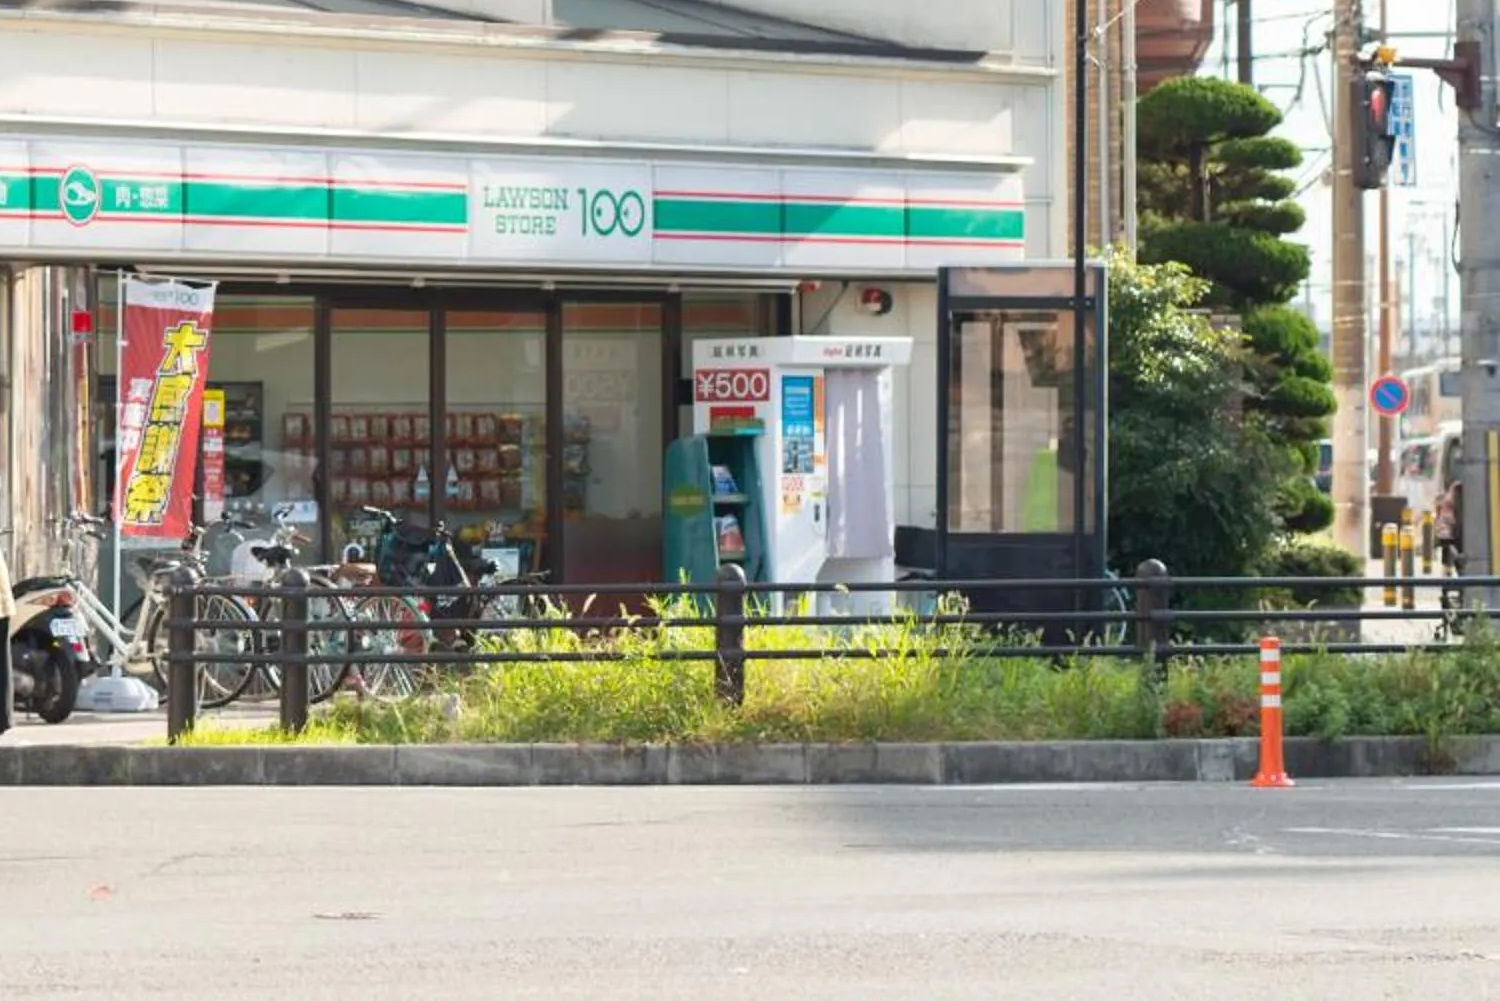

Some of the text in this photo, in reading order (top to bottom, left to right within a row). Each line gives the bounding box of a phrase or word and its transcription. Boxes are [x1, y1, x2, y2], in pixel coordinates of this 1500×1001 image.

[484, 186, 569, 210] LAWSON
[577, 188, 645, 236] 100
[495, 215, 557, 235] STORE
[699, 372, 768, 399] ¥500
